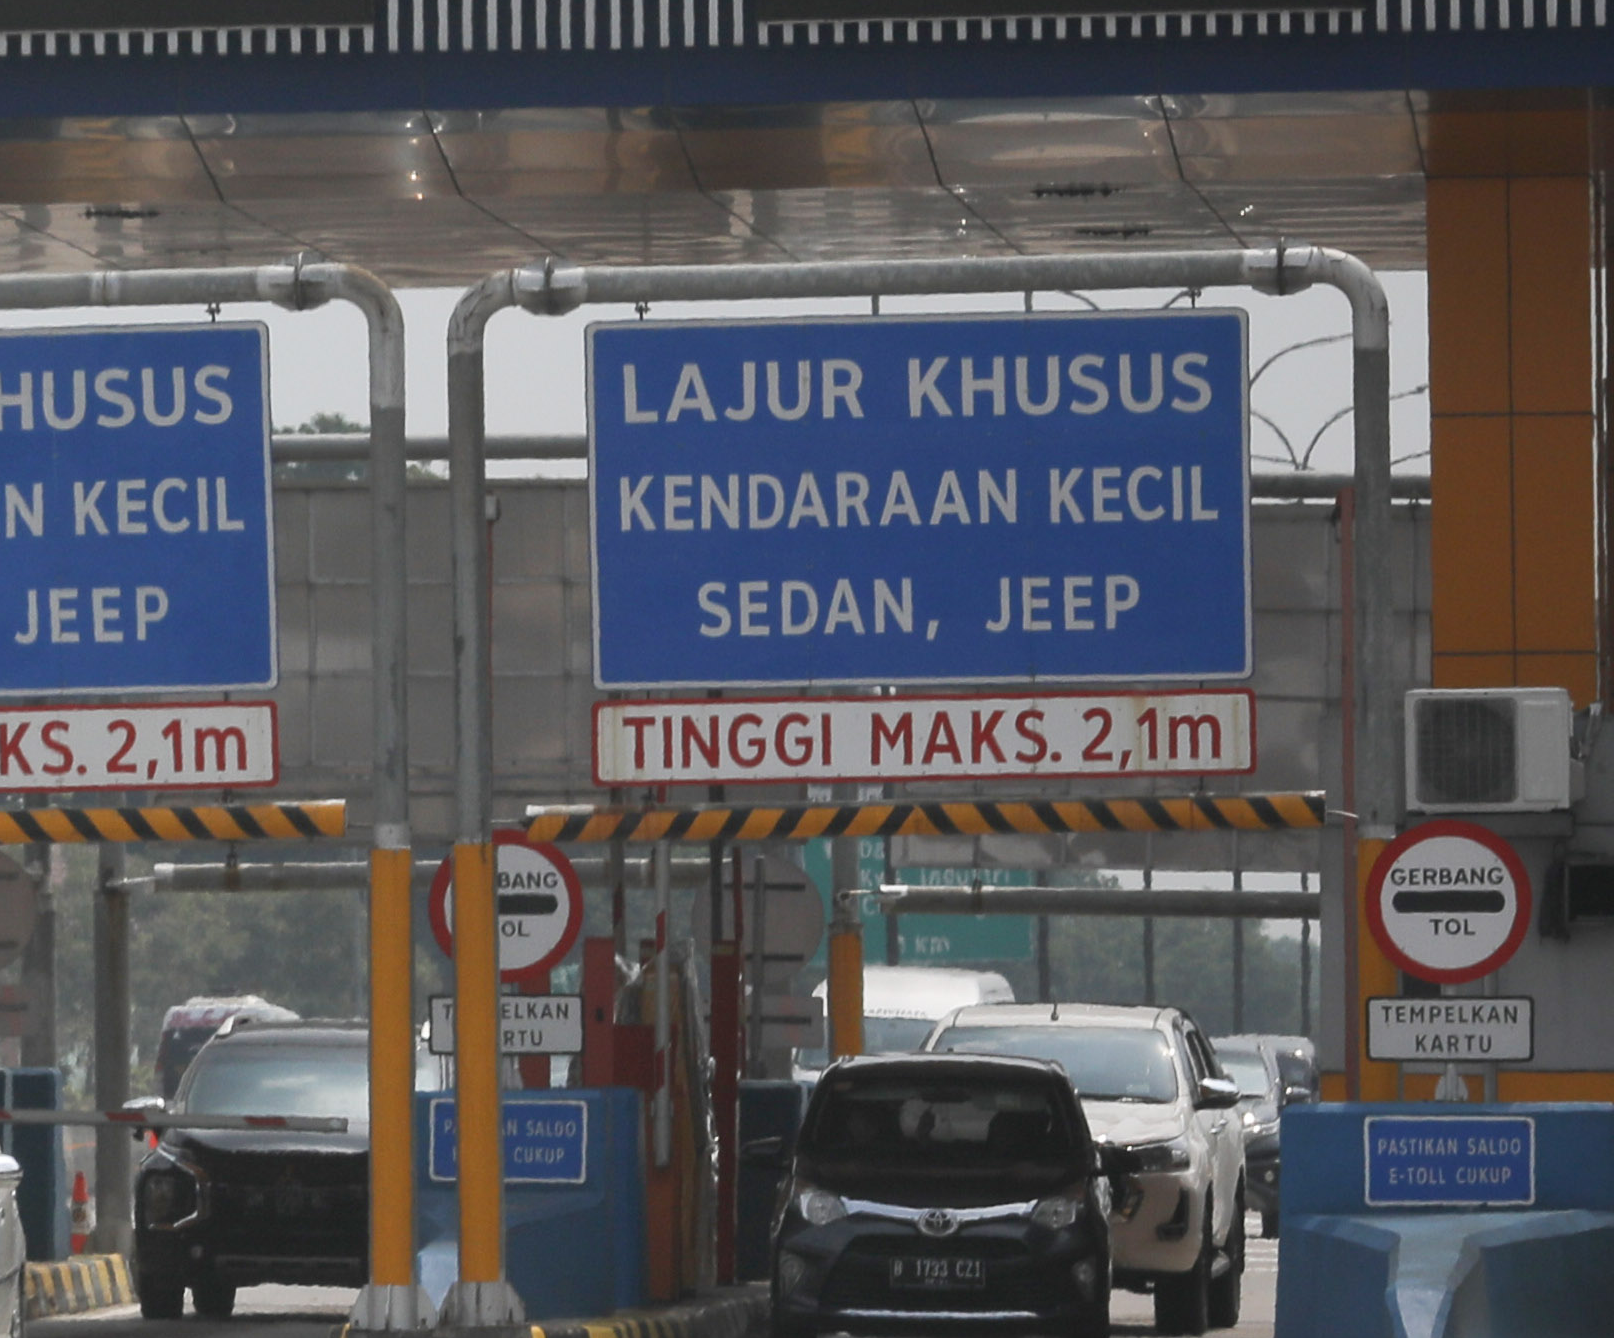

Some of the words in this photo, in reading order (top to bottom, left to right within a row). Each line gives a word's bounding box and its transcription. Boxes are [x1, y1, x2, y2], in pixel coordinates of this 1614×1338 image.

[622, 358, 865, 424] LAJUR
[908, 352, 1213, 417] KHUSUS
[74, 476, 245, 535] KECIL
[620, 469, 1018, 531] KENDARAAN
[1049, 465, 1219, 522] KECIL
[15, 586, 170, 645] JEEP
[697, 576, 941, 641] SEDAN,
[985, 574, 1140, 633] JEEP
[622, 711, 833, 769] TINGGI
[870, 708, 1063, 765] MAKS.
[498, 872, 558, 889] BANG
[1390, 867, 1504, 886] GERBANG
[501, 920, 530, 938] OL
[1429, 918, 1476, 936] TOL
[442, 1003, 569, 1021] TELKAN
[1381, 1005, 1519, 1025] TEMPELKAN
[503, 1030, 543, 1046] RTU
[1414, 1034, 1493, 1054] KARTU
[526, 1119, 577, 1135] SALDO
[514, 1146, 565, 1162] CUKUP
[1377, 1138, 1458, 1156] PASTIKAN
[1467, 1137, 1521, 1155] SALDO
[1389, 1167, 1446, 1185] E-TOLL
[1456, 1167, 1512, 1184] CUKUP
